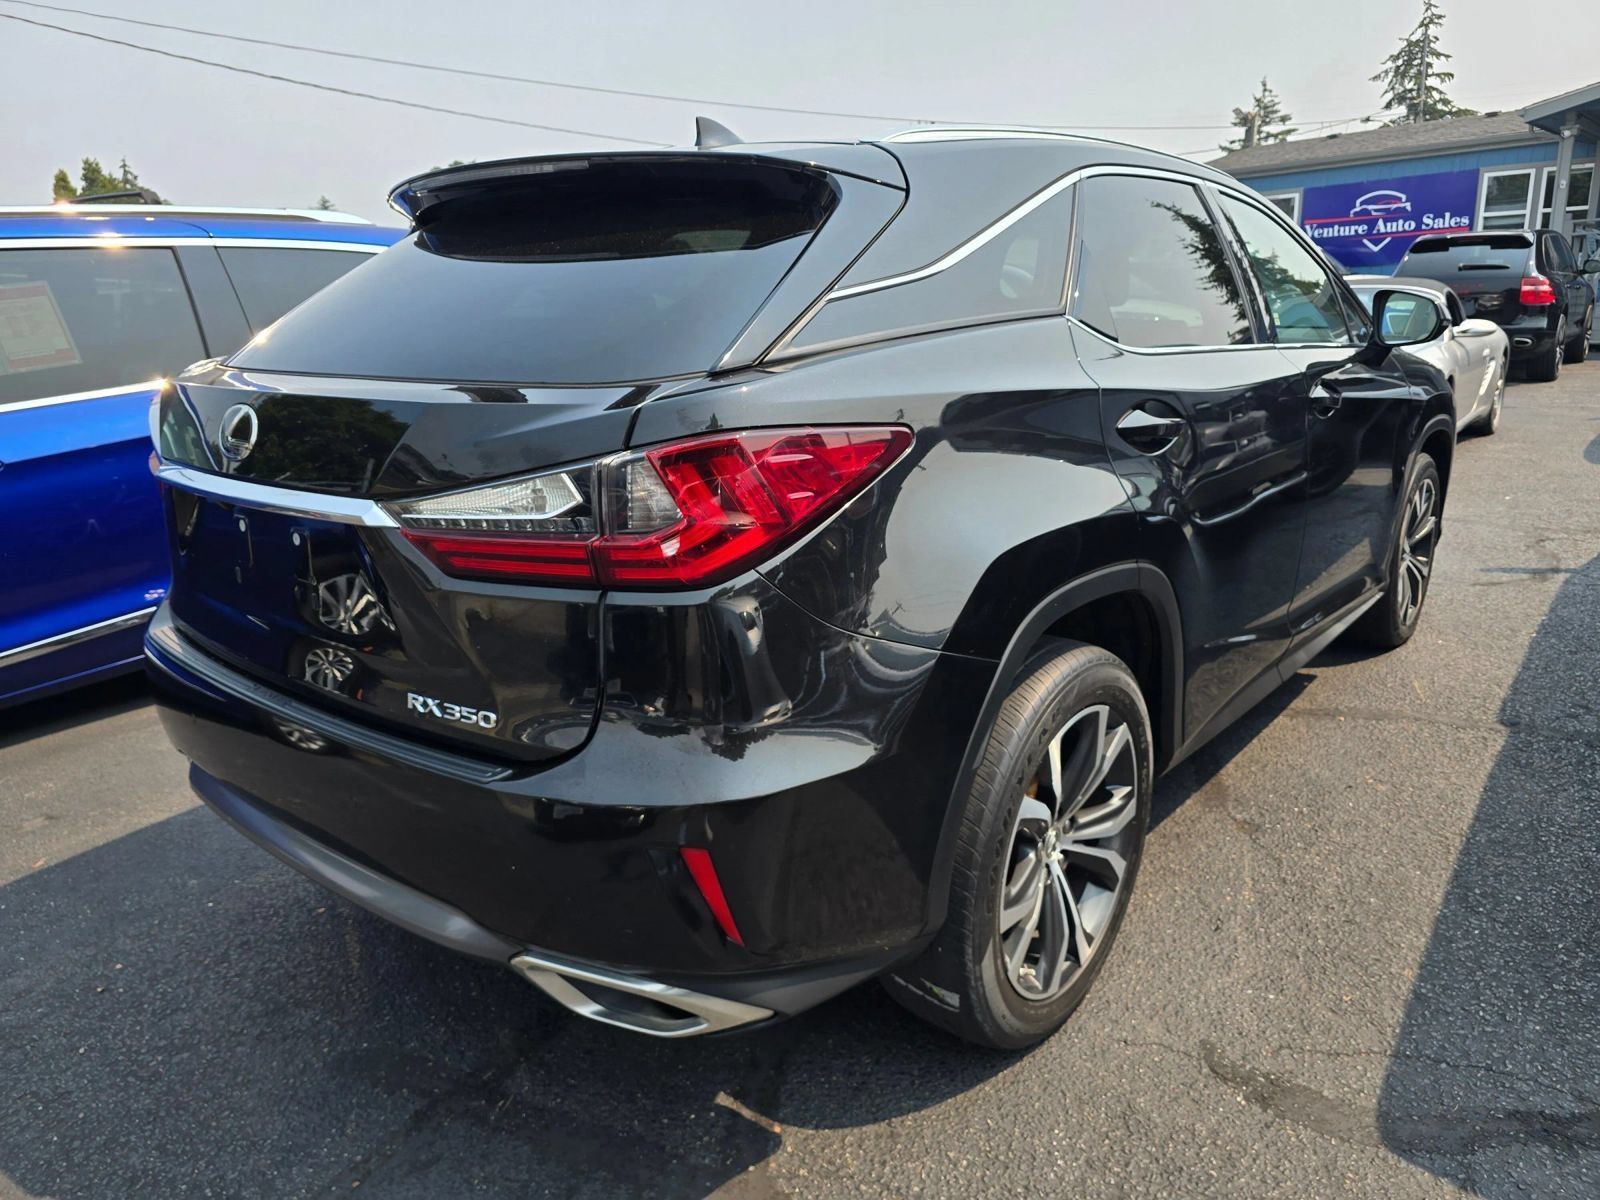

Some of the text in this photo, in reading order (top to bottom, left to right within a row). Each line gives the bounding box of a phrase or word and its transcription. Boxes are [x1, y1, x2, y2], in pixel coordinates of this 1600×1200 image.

[1304, 212, 1470, 239] Venture Auto Sales
